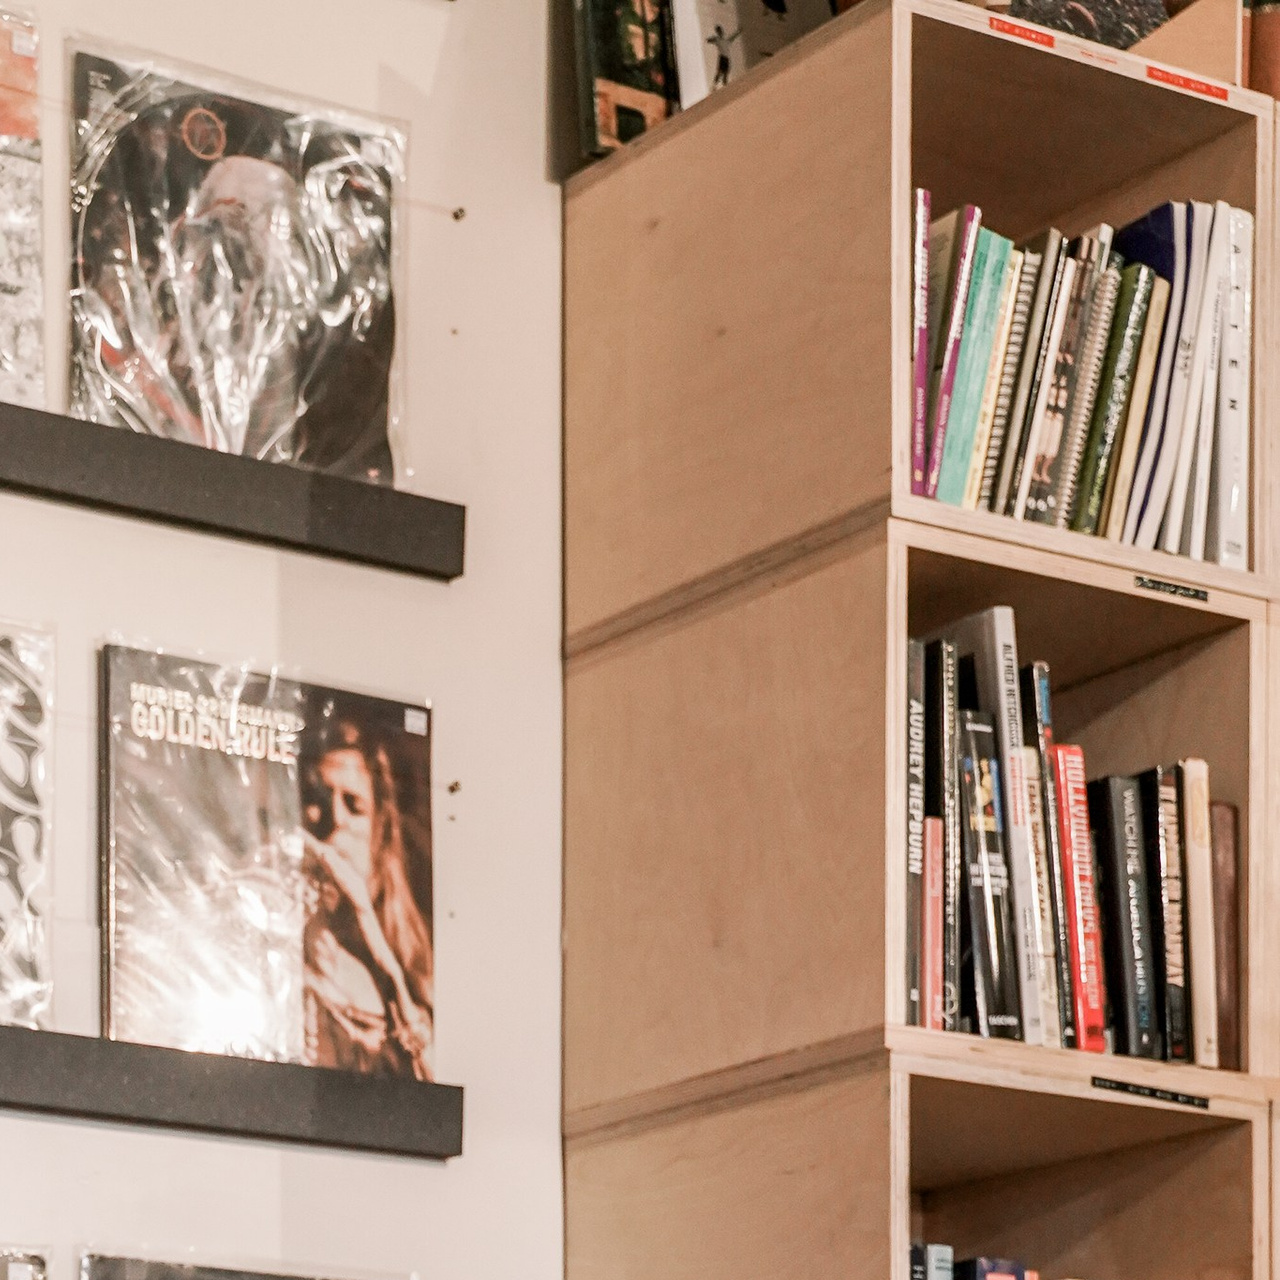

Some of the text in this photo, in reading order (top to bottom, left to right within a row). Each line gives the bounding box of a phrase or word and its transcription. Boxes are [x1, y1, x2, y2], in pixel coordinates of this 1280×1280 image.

[130, 701, 228, 753] GOLDEN
[908, 700, 926, 876] AUDREY HEPBURN
